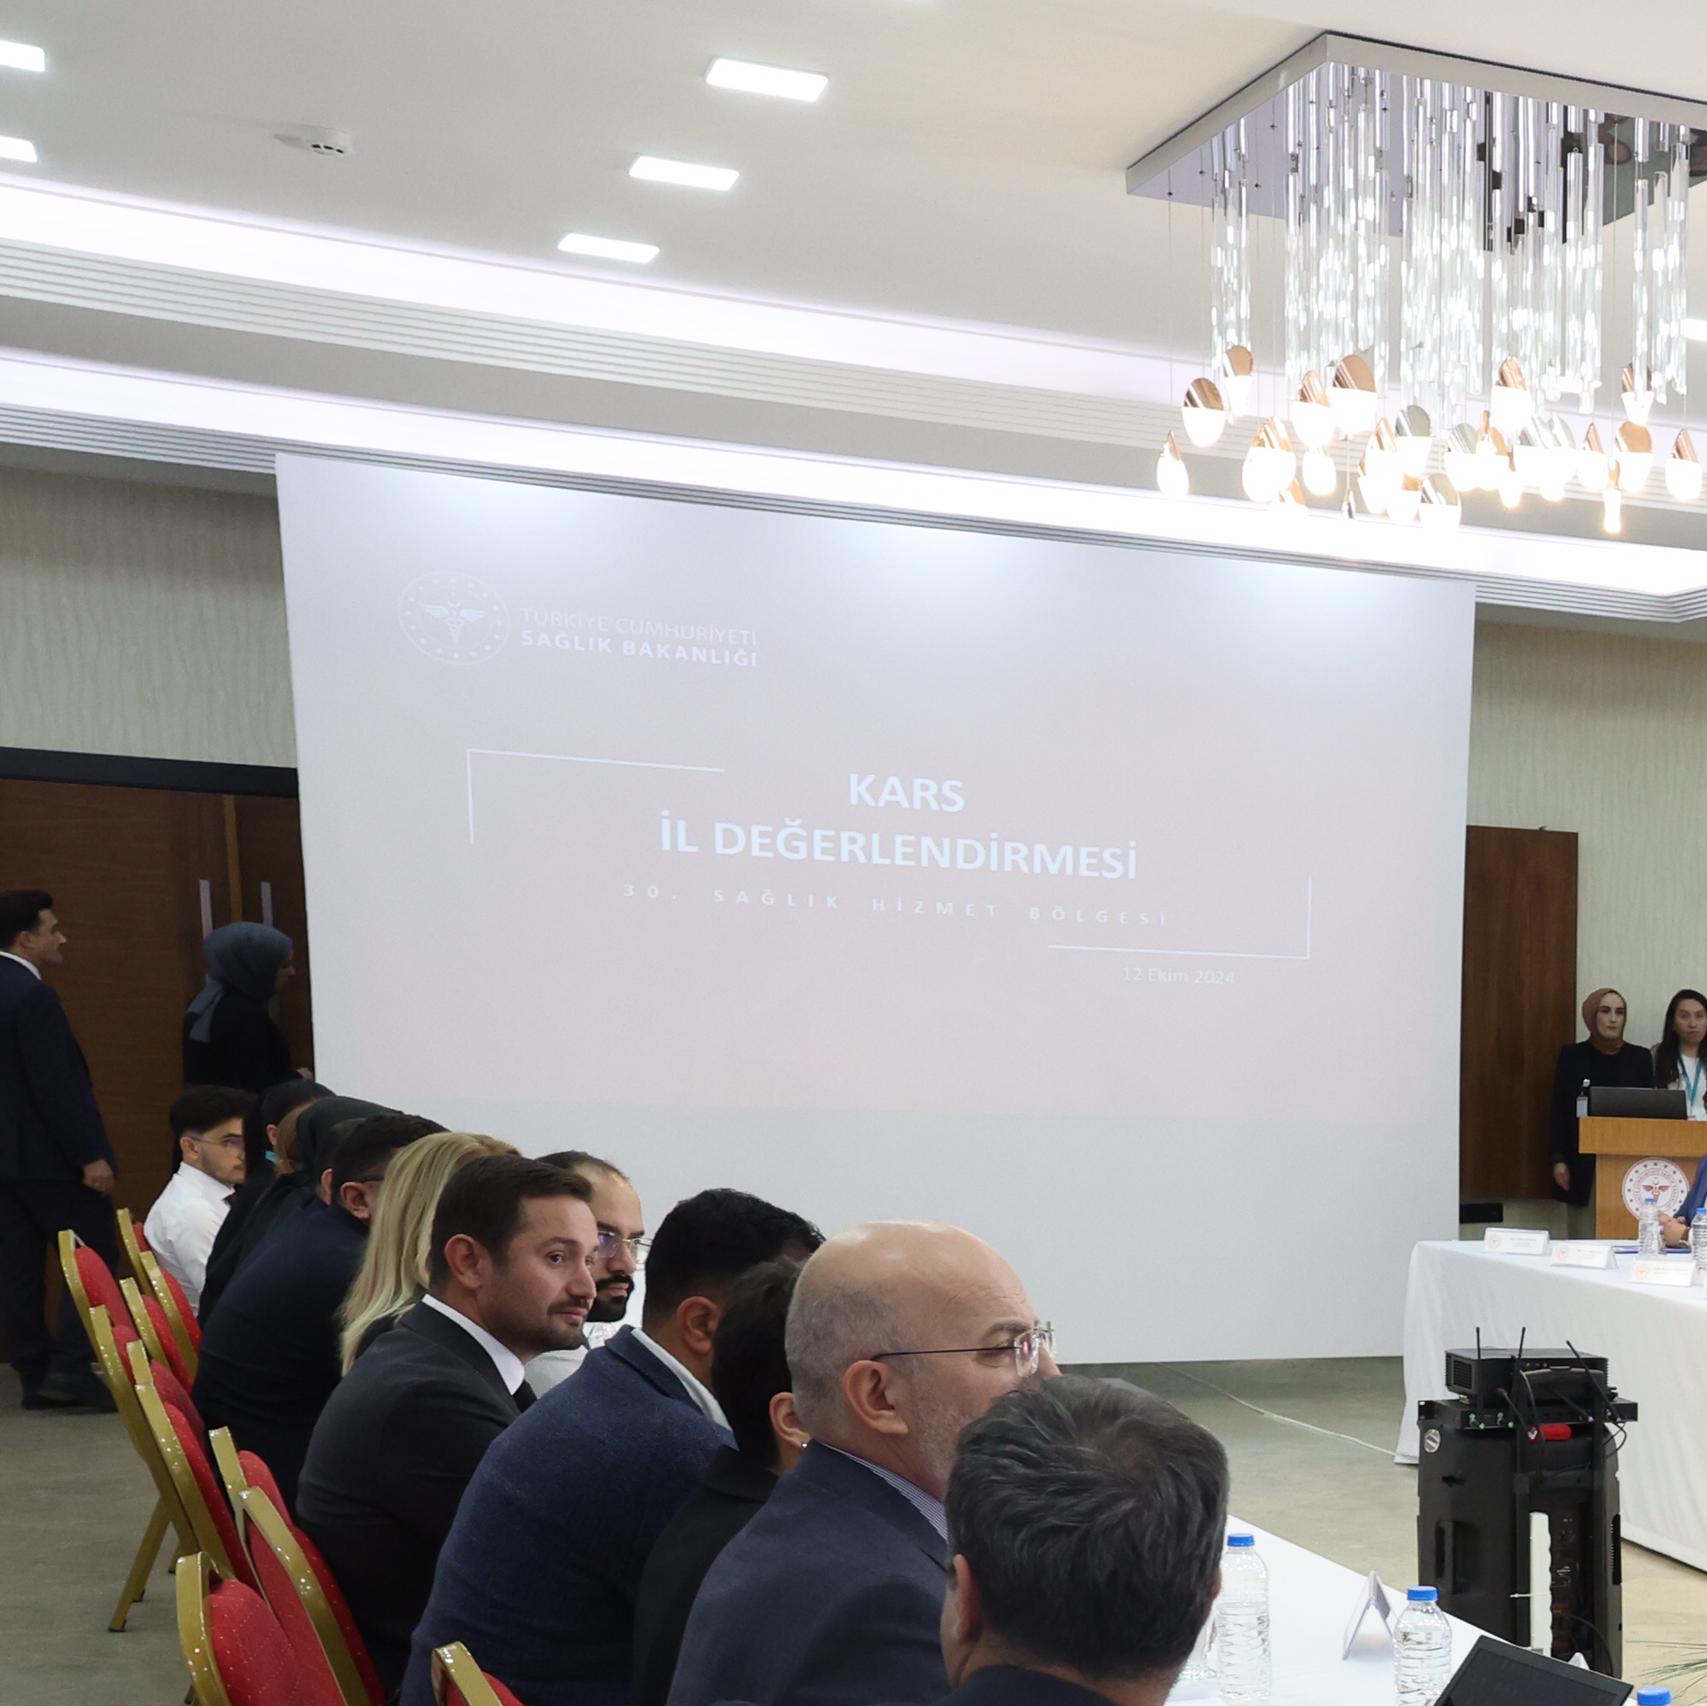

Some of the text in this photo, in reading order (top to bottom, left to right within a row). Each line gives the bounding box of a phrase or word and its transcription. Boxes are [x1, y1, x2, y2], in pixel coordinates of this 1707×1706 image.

[520, 629, 758, 668] SAĞLIK BAKANLIĞI
[848, 772, 966, 813] KARS
[659, 810, 1138, 879] İL DEĞERLENDİRMESİ
[622, 883, 1167, 926] 30. SAĞLIK HİZMET BÖLGESİ
[1121, 967, 1236, 985] 12 Ekim 2024
